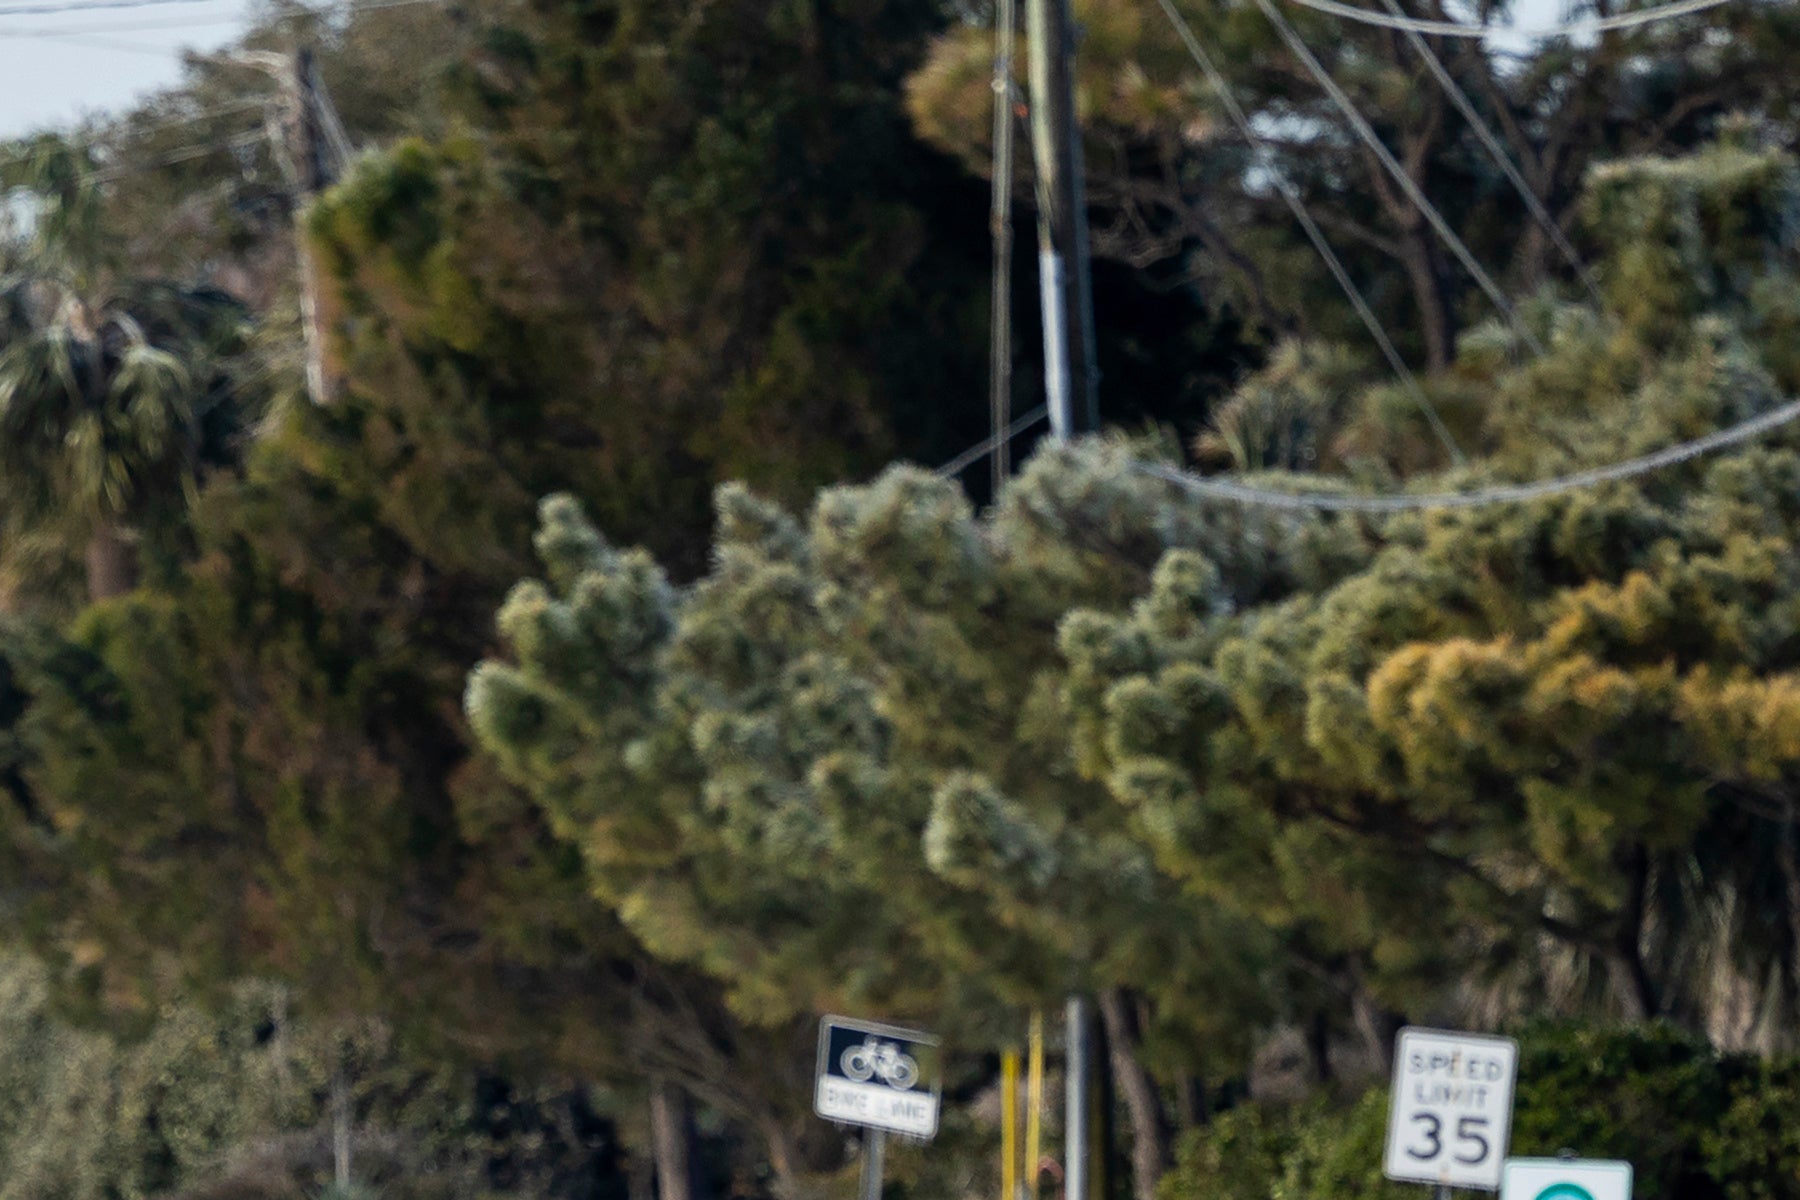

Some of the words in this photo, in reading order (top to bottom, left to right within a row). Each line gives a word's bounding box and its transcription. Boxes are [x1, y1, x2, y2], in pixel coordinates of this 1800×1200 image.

[1408, 1050, 1503, 1081] SPEED
[1414, 1083, 1489, 1109] LIMIT
[1405, 1111, 1490, 1166] 35
